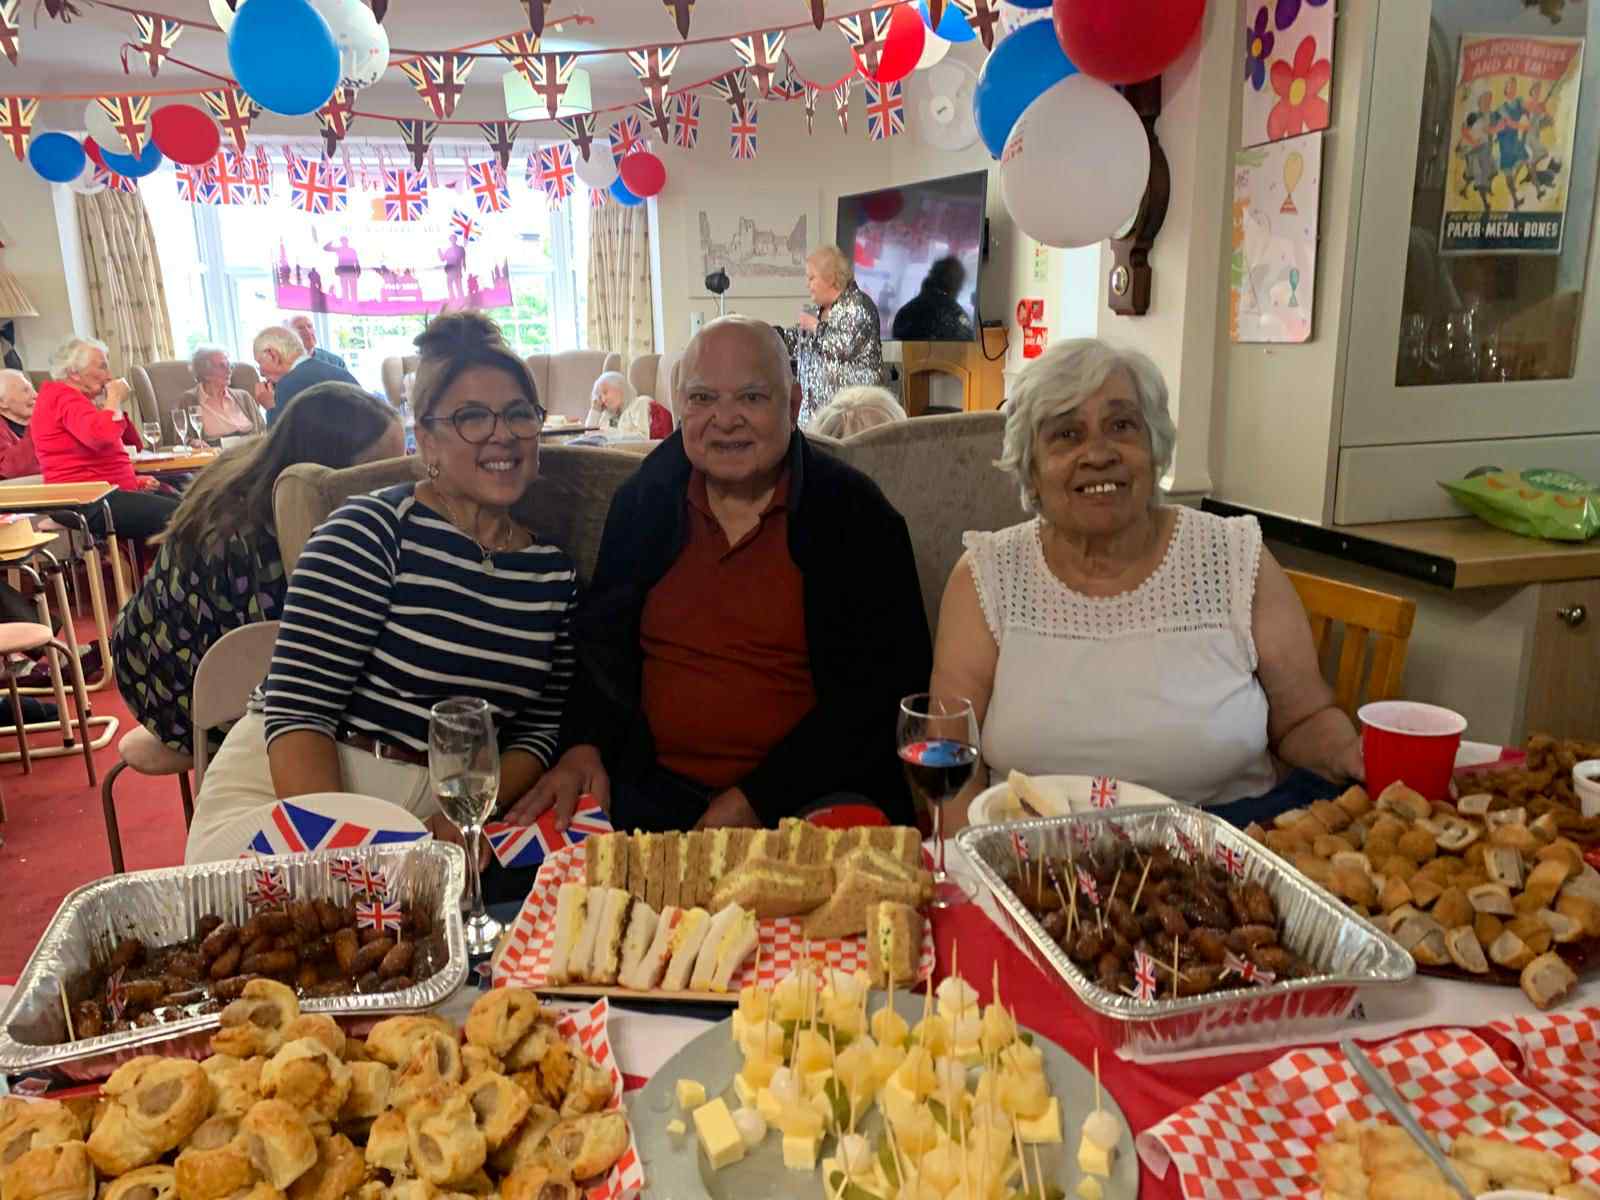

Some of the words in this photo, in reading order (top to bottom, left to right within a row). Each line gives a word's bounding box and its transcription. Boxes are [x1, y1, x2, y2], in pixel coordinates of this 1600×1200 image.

[1447, 221, 1480, 238] PAPER
[1485, 221, 1519, 238] METAL
[1523, 221, 1559, 237] BONES
